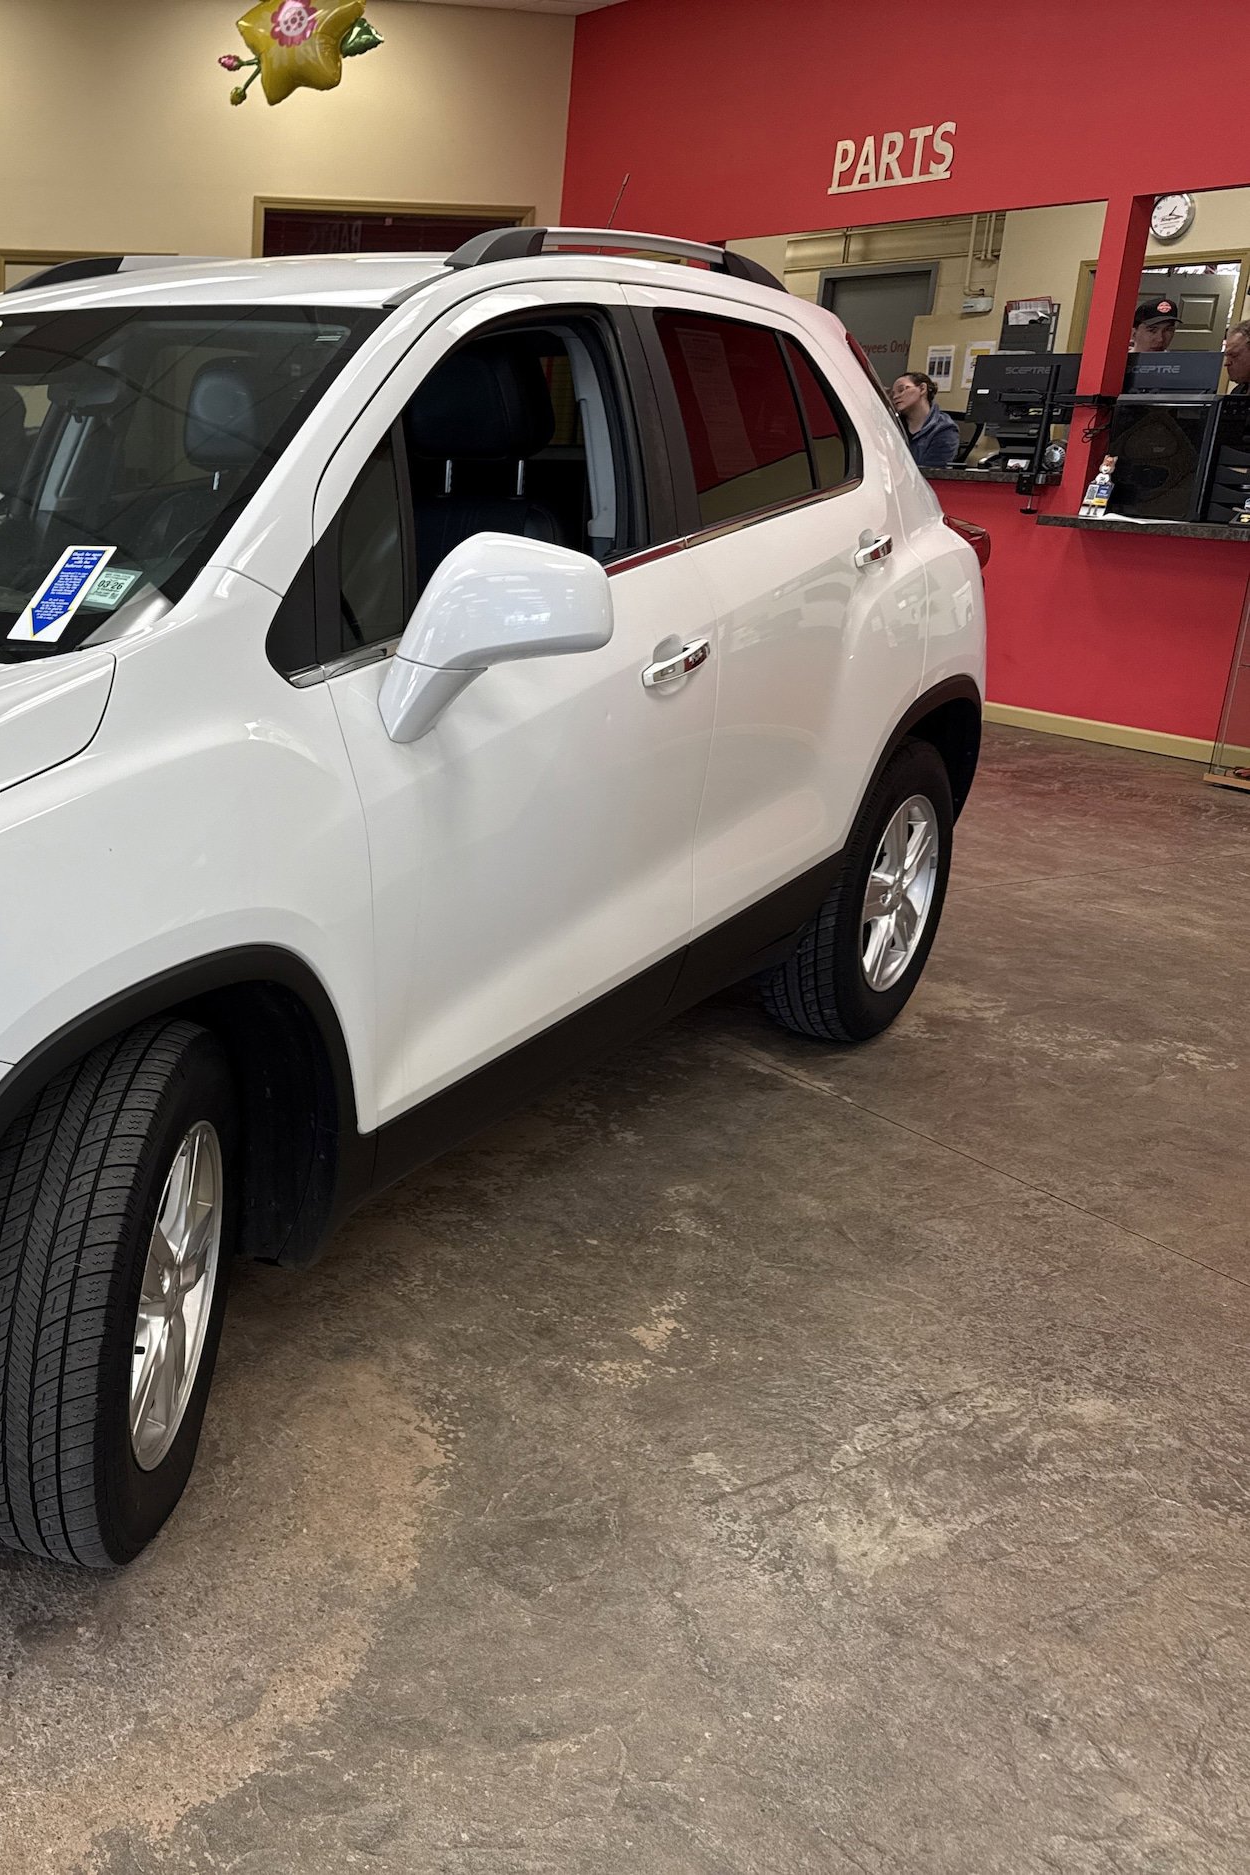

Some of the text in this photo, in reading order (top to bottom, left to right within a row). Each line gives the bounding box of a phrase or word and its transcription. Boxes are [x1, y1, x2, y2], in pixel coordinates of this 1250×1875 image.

[829, 121, 957, 192] PARTS
[890, 340, 911, 356] Only
[1005, 366, 1051, 375] SCEPTRE
[97, 579, 125, 590] 03 26
